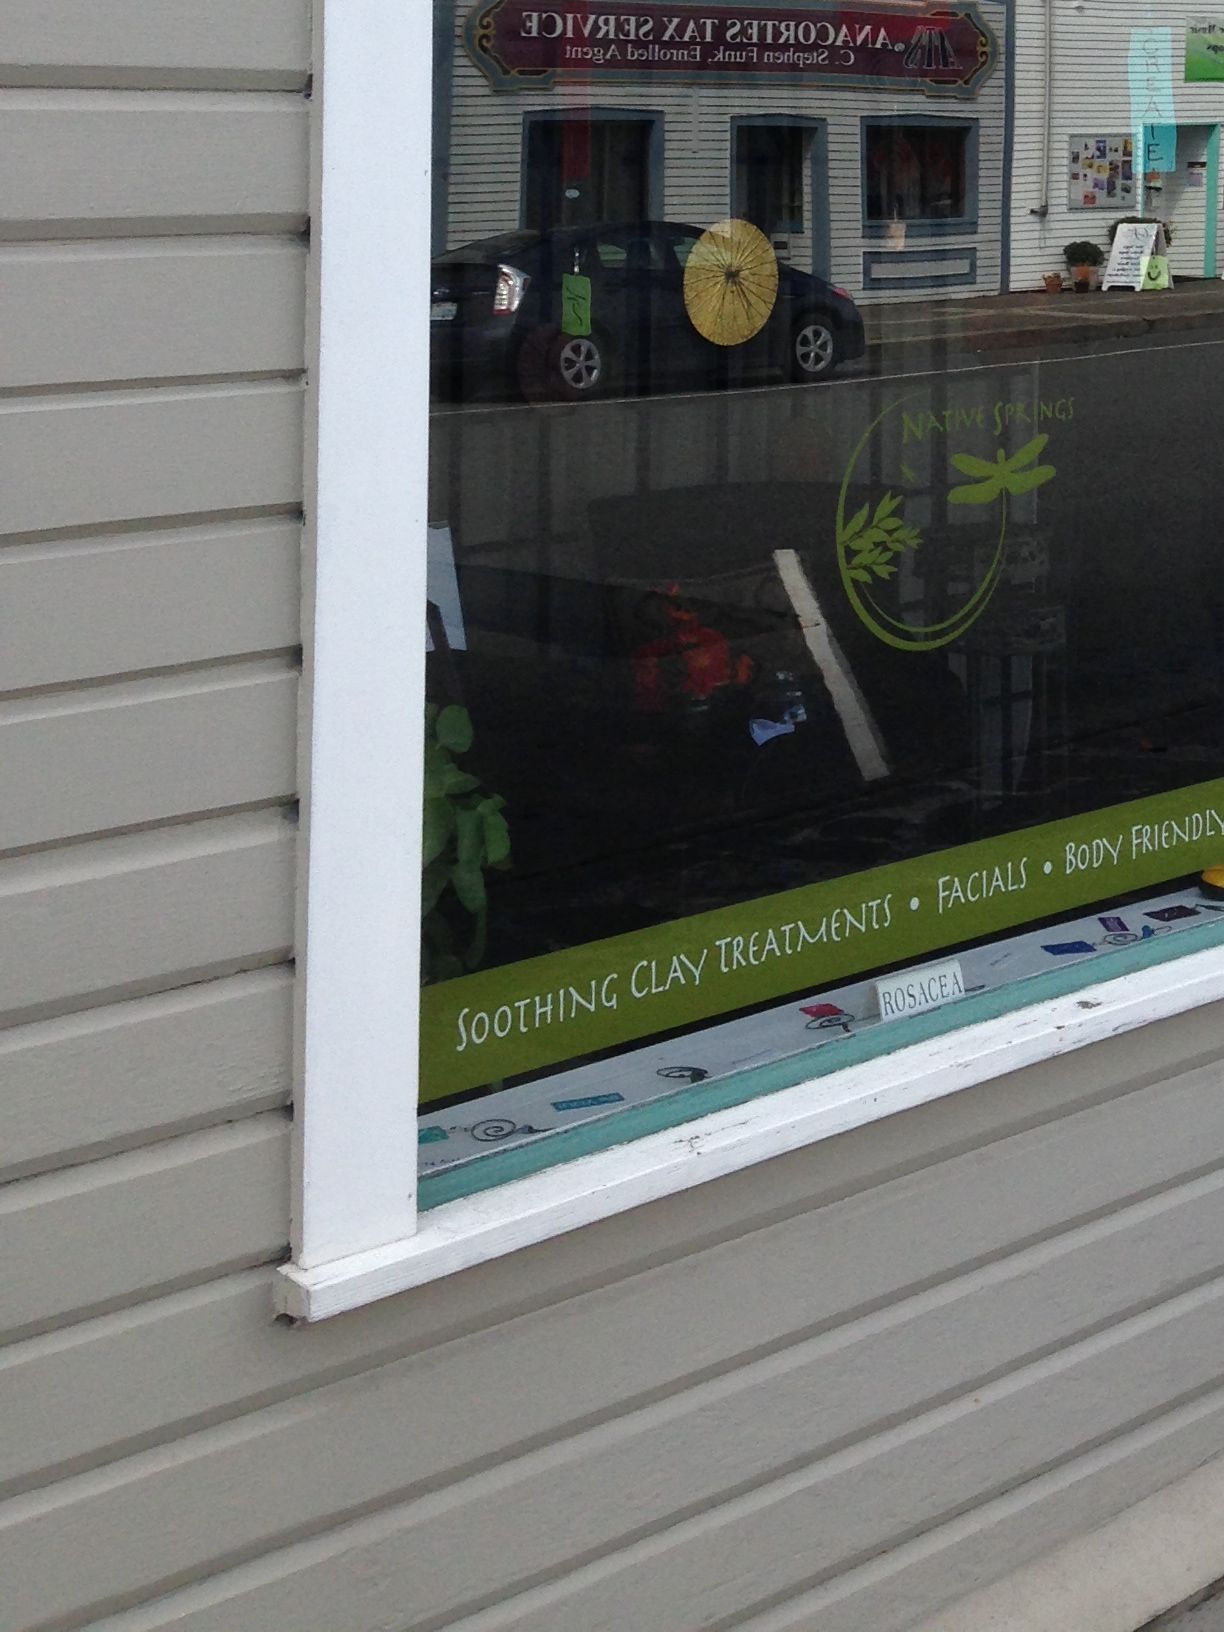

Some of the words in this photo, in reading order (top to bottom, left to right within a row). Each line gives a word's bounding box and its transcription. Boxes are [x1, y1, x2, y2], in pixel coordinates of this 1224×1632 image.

[902, 404, 986, 445] NATIVE
[993, 396, 1076, 436] SPRINGS
[455, 973, 619, 1053] SOOTHING
[629, 948, 709, 1001] CLAY
[714, 893, 893, 973] TREATMENTS
[937, 857, 1028, 913] FACIALS
[1063, 834, 1124, 876] BODY
[882, 971, 963, 1017] ROSACEA
